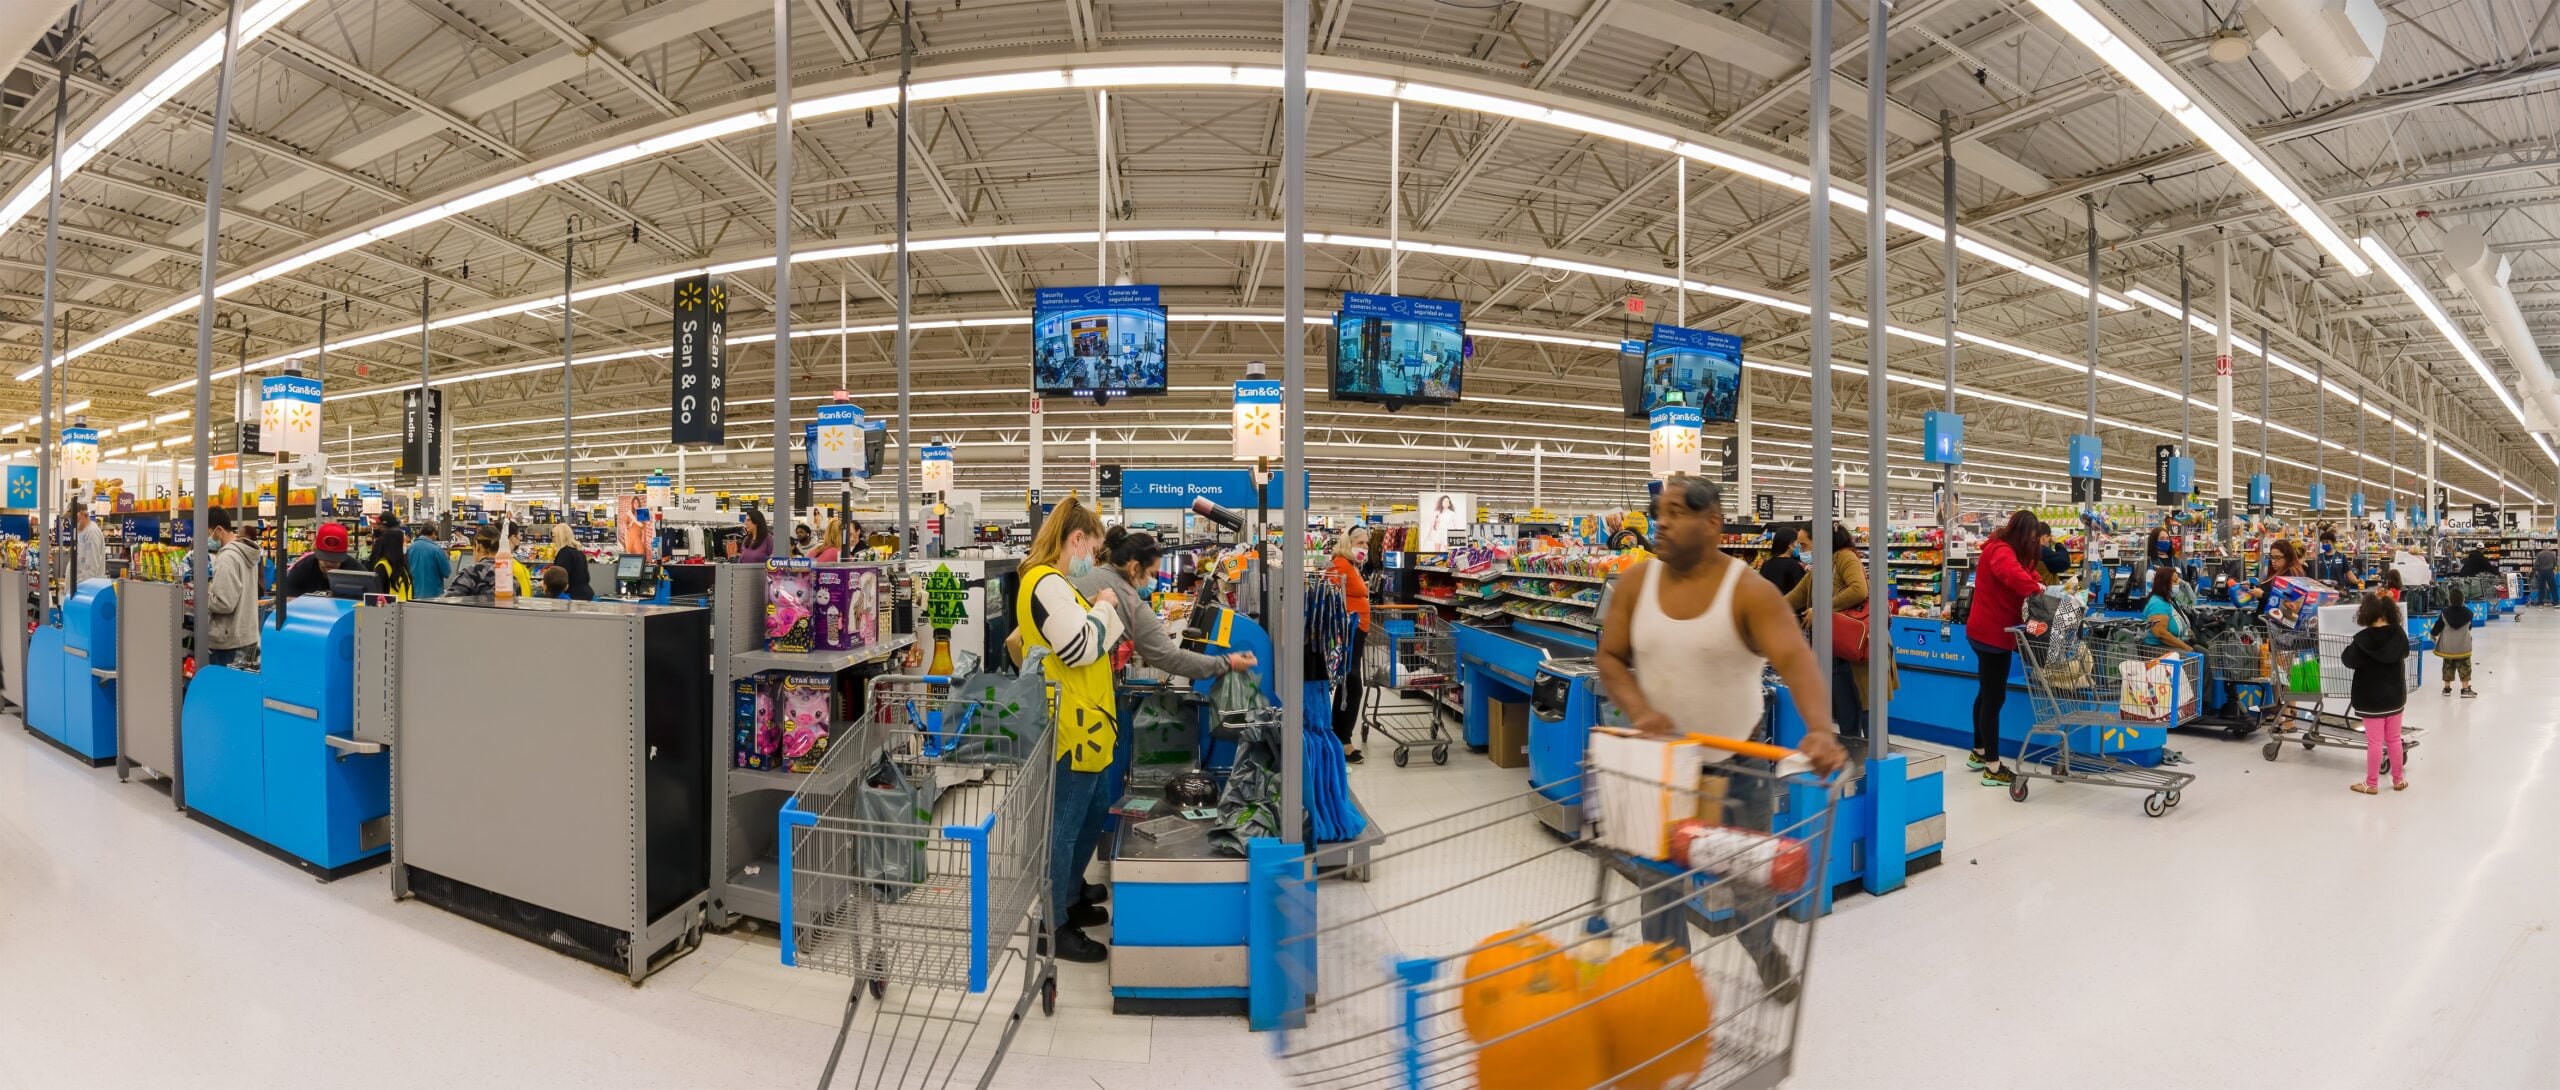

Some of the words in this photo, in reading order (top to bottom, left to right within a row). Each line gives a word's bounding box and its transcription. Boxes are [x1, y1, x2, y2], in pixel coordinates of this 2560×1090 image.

[1042, 291, 1063, 300] Security
[1350, 296, 1372, 304] Security
[1628, 299, 1644, 312] EXIT
[1658, 327, 1675, 335] Security
[682, 320, 698, 368] Scan
[711, 321, 721, 369] Scan
[682, 374, 696, 390] &
[711, 374, 721, 390] &
[287, 383, 321, 397] Scan&Go
[1238, 387, 1280, 397] Scan&Go
[681, 394, 696, 425] Go
[710, 395, 720, 425] Go
[1669, 411, 1700, 421] Scan&Go
[408, 411, 416, 444] Ladies
[73, 432, 98, 441] Scan&Go
[1943, 437, 1949, 456] 1
[2082, 455, 2090, 472] 2
[2181, 474, 2186, 487] 3
[156, 484, 193, 500] Baer
[1149, 483, 1184, 496] Fitting
[1188, 483, 1223, 494] Rooms
[682, 496, 702, 504] Ladies'
[2378, 519, 2398, 529] Tos
[5, 532, 21, 540] Price
[772, 559, 788, 567] STAR
[790, 559, 810, 567] BELLY
[950, 571, 970, 579] LIKE
[929, 591, 969, 600] REWED
[921, 600, 969, 619] TEA
[1896, 646, 1909, 655] Save
[1910, 649, 1929, 659] money
[1931, 650, 1945, 659] Lie
[1945, 651, 1966, 662] bettr
